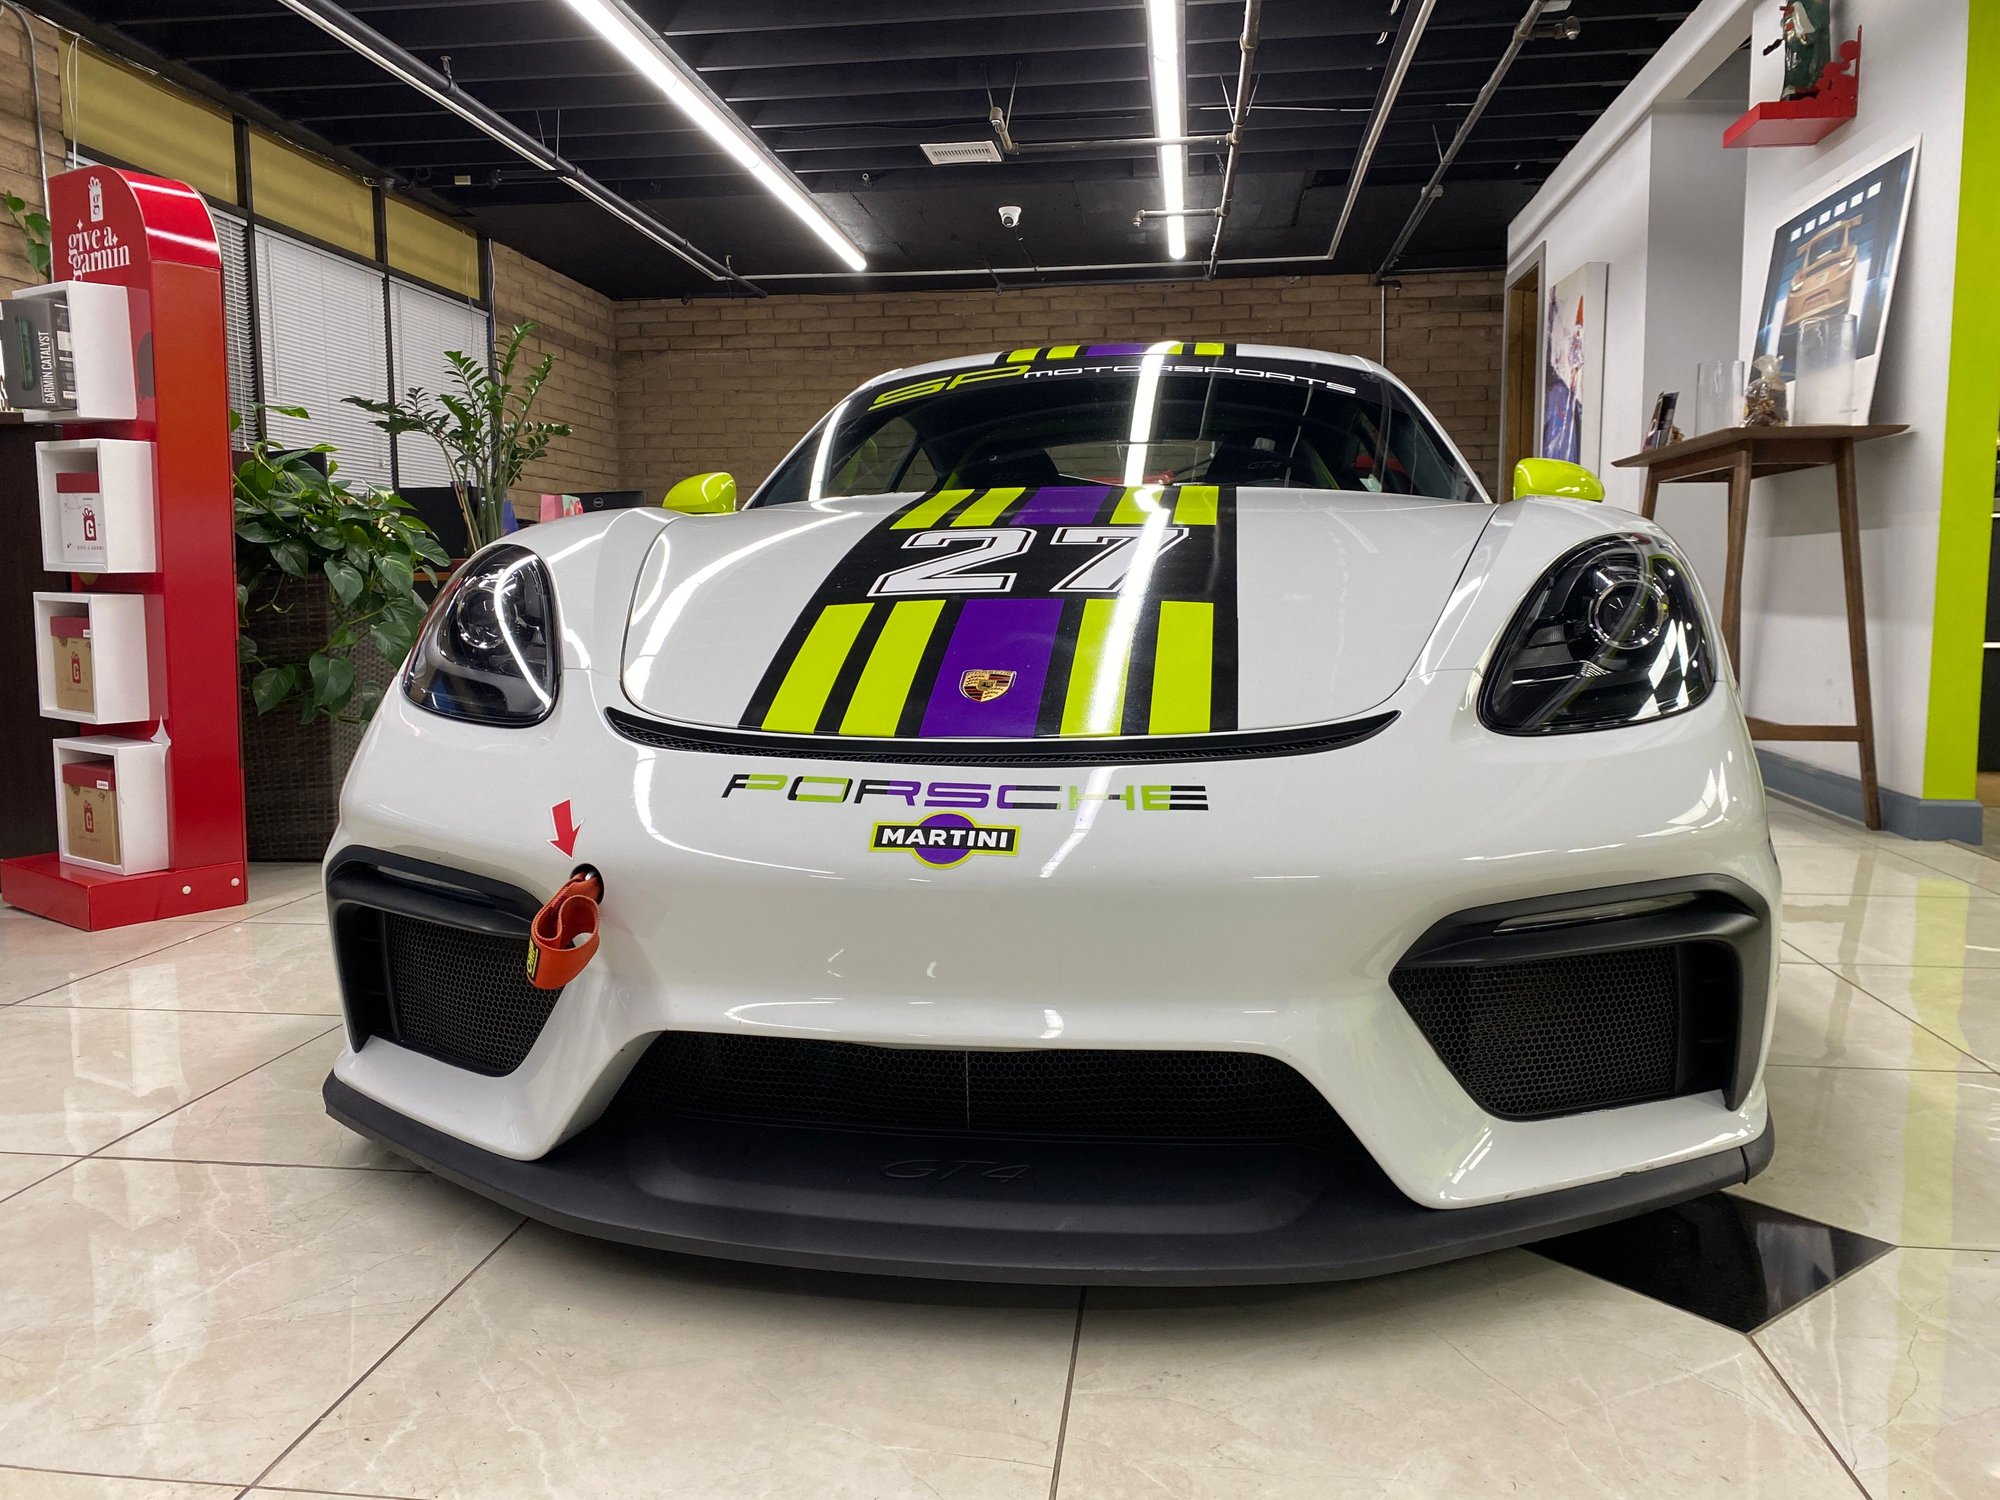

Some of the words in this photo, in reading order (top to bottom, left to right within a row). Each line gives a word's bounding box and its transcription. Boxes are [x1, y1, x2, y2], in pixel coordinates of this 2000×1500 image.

[68, 228, 101, 265] give
[103, 226, 113, 247] a
[73, 244, 131, 281] garmin
[37, 330, 53, 369] CATALYST
[42, 371, 56, 403] GARMIN
[867, 365, 1031, 411] SP
[85, 519, 95, 538] G
[866, 527, 1190, 597] 27
[73, 662, 80, 681] G
[721, 773, 1209, 811] PORSCHE
[85, 812, 93, 829] G
[881, 828, 1009, 848] MARTINI
[884, 1159, 1031, 1184] GT4
